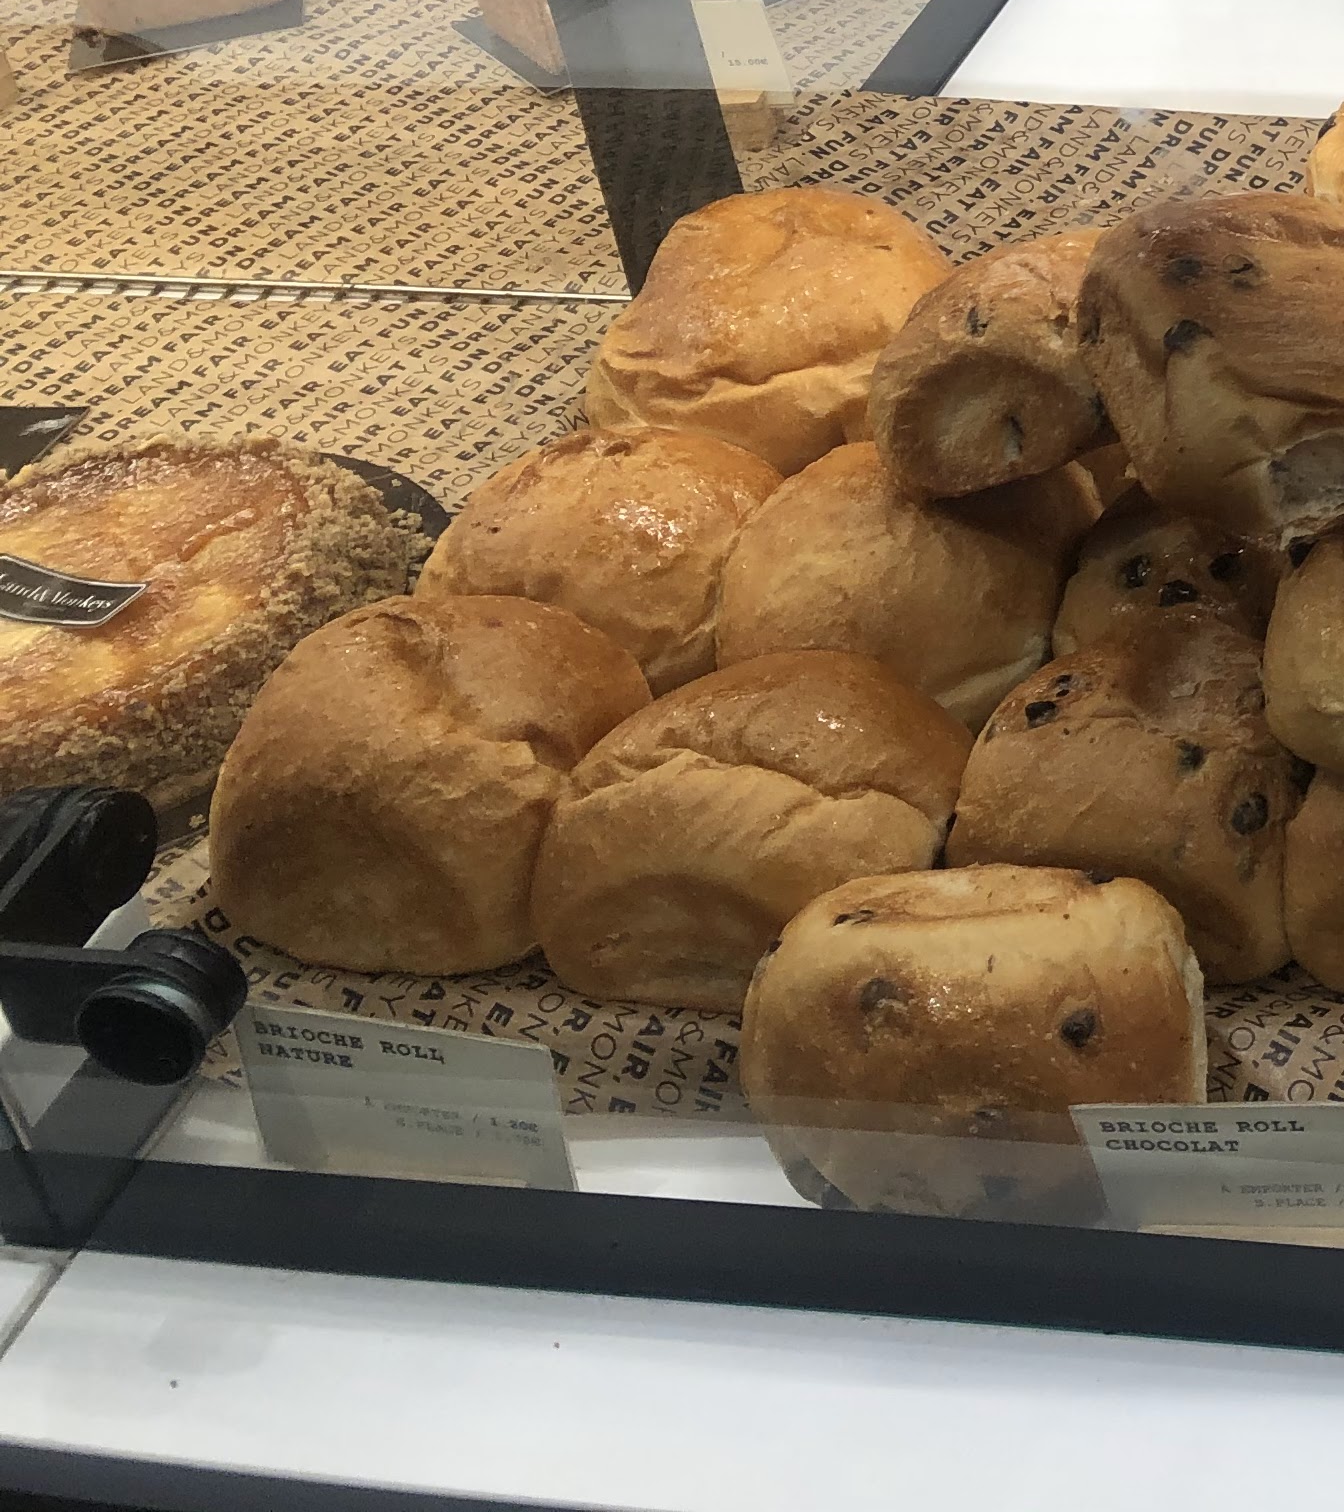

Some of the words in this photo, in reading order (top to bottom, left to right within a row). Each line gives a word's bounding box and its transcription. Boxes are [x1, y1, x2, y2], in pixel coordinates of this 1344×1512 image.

[252, 1020, 364, 1050] BRIOCHE
[379, 1040, 445, 1064] ROLL
[257, 1042, 354, 1069] NATURE
[1100, 1120, 1218, 1134] BRIOCHE
[1236, 1120, 1305, 1133] ROLL
[1105, 1139, 1240, 1153] CHOCOLAT
